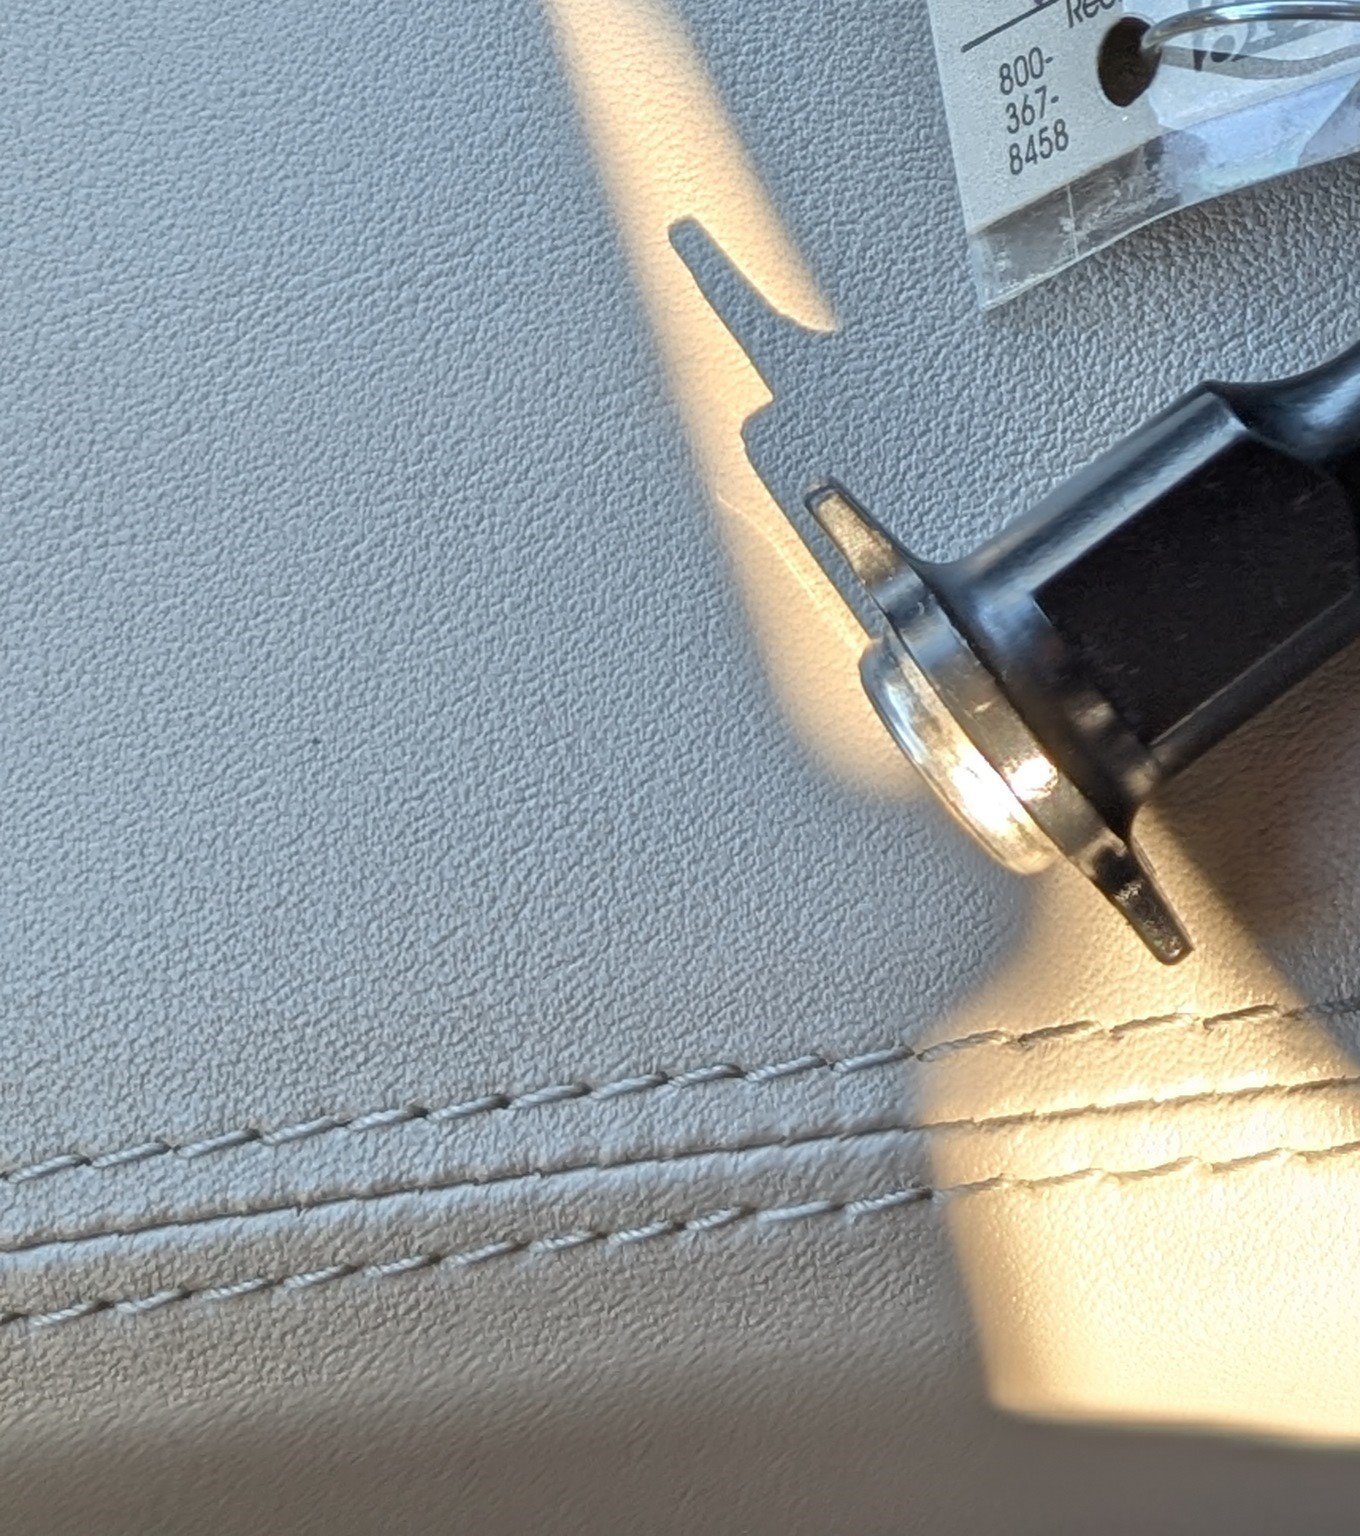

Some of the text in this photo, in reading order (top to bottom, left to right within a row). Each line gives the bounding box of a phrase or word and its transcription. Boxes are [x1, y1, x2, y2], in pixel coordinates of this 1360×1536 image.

[1000, 45, 1054, 95] 800-
[1006, 92, 1060, 134] 367-
[1008, 119, 1070, 176] 8458
